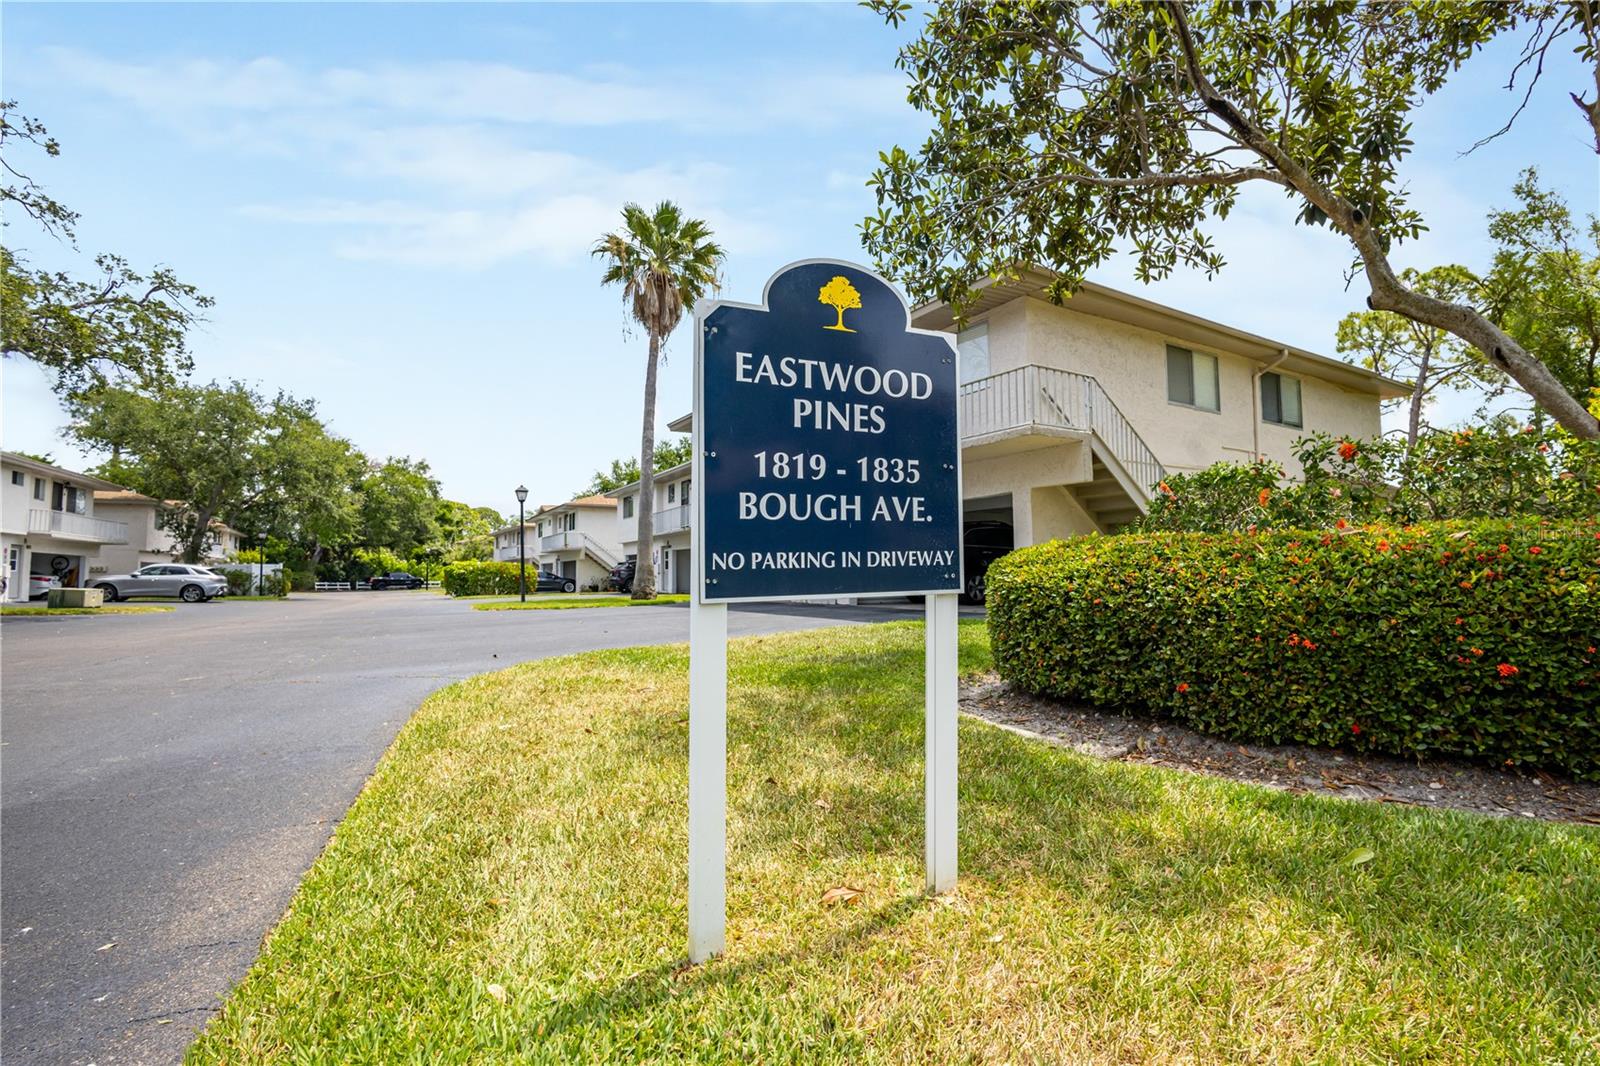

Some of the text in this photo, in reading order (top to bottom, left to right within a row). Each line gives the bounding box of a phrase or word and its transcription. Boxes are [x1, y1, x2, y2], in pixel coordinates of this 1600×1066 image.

[736, 351, 933, 400] EASTWOOD
[794, 399, 885, 433] PINES
[754, 451, 827, 480] 1819
[857, 457, 920, 484] 1835
[739, 492, 933, 522] BOUGH AVE.
[713, 551, 953, 570] NO PARKING IN DRIVEWAY
